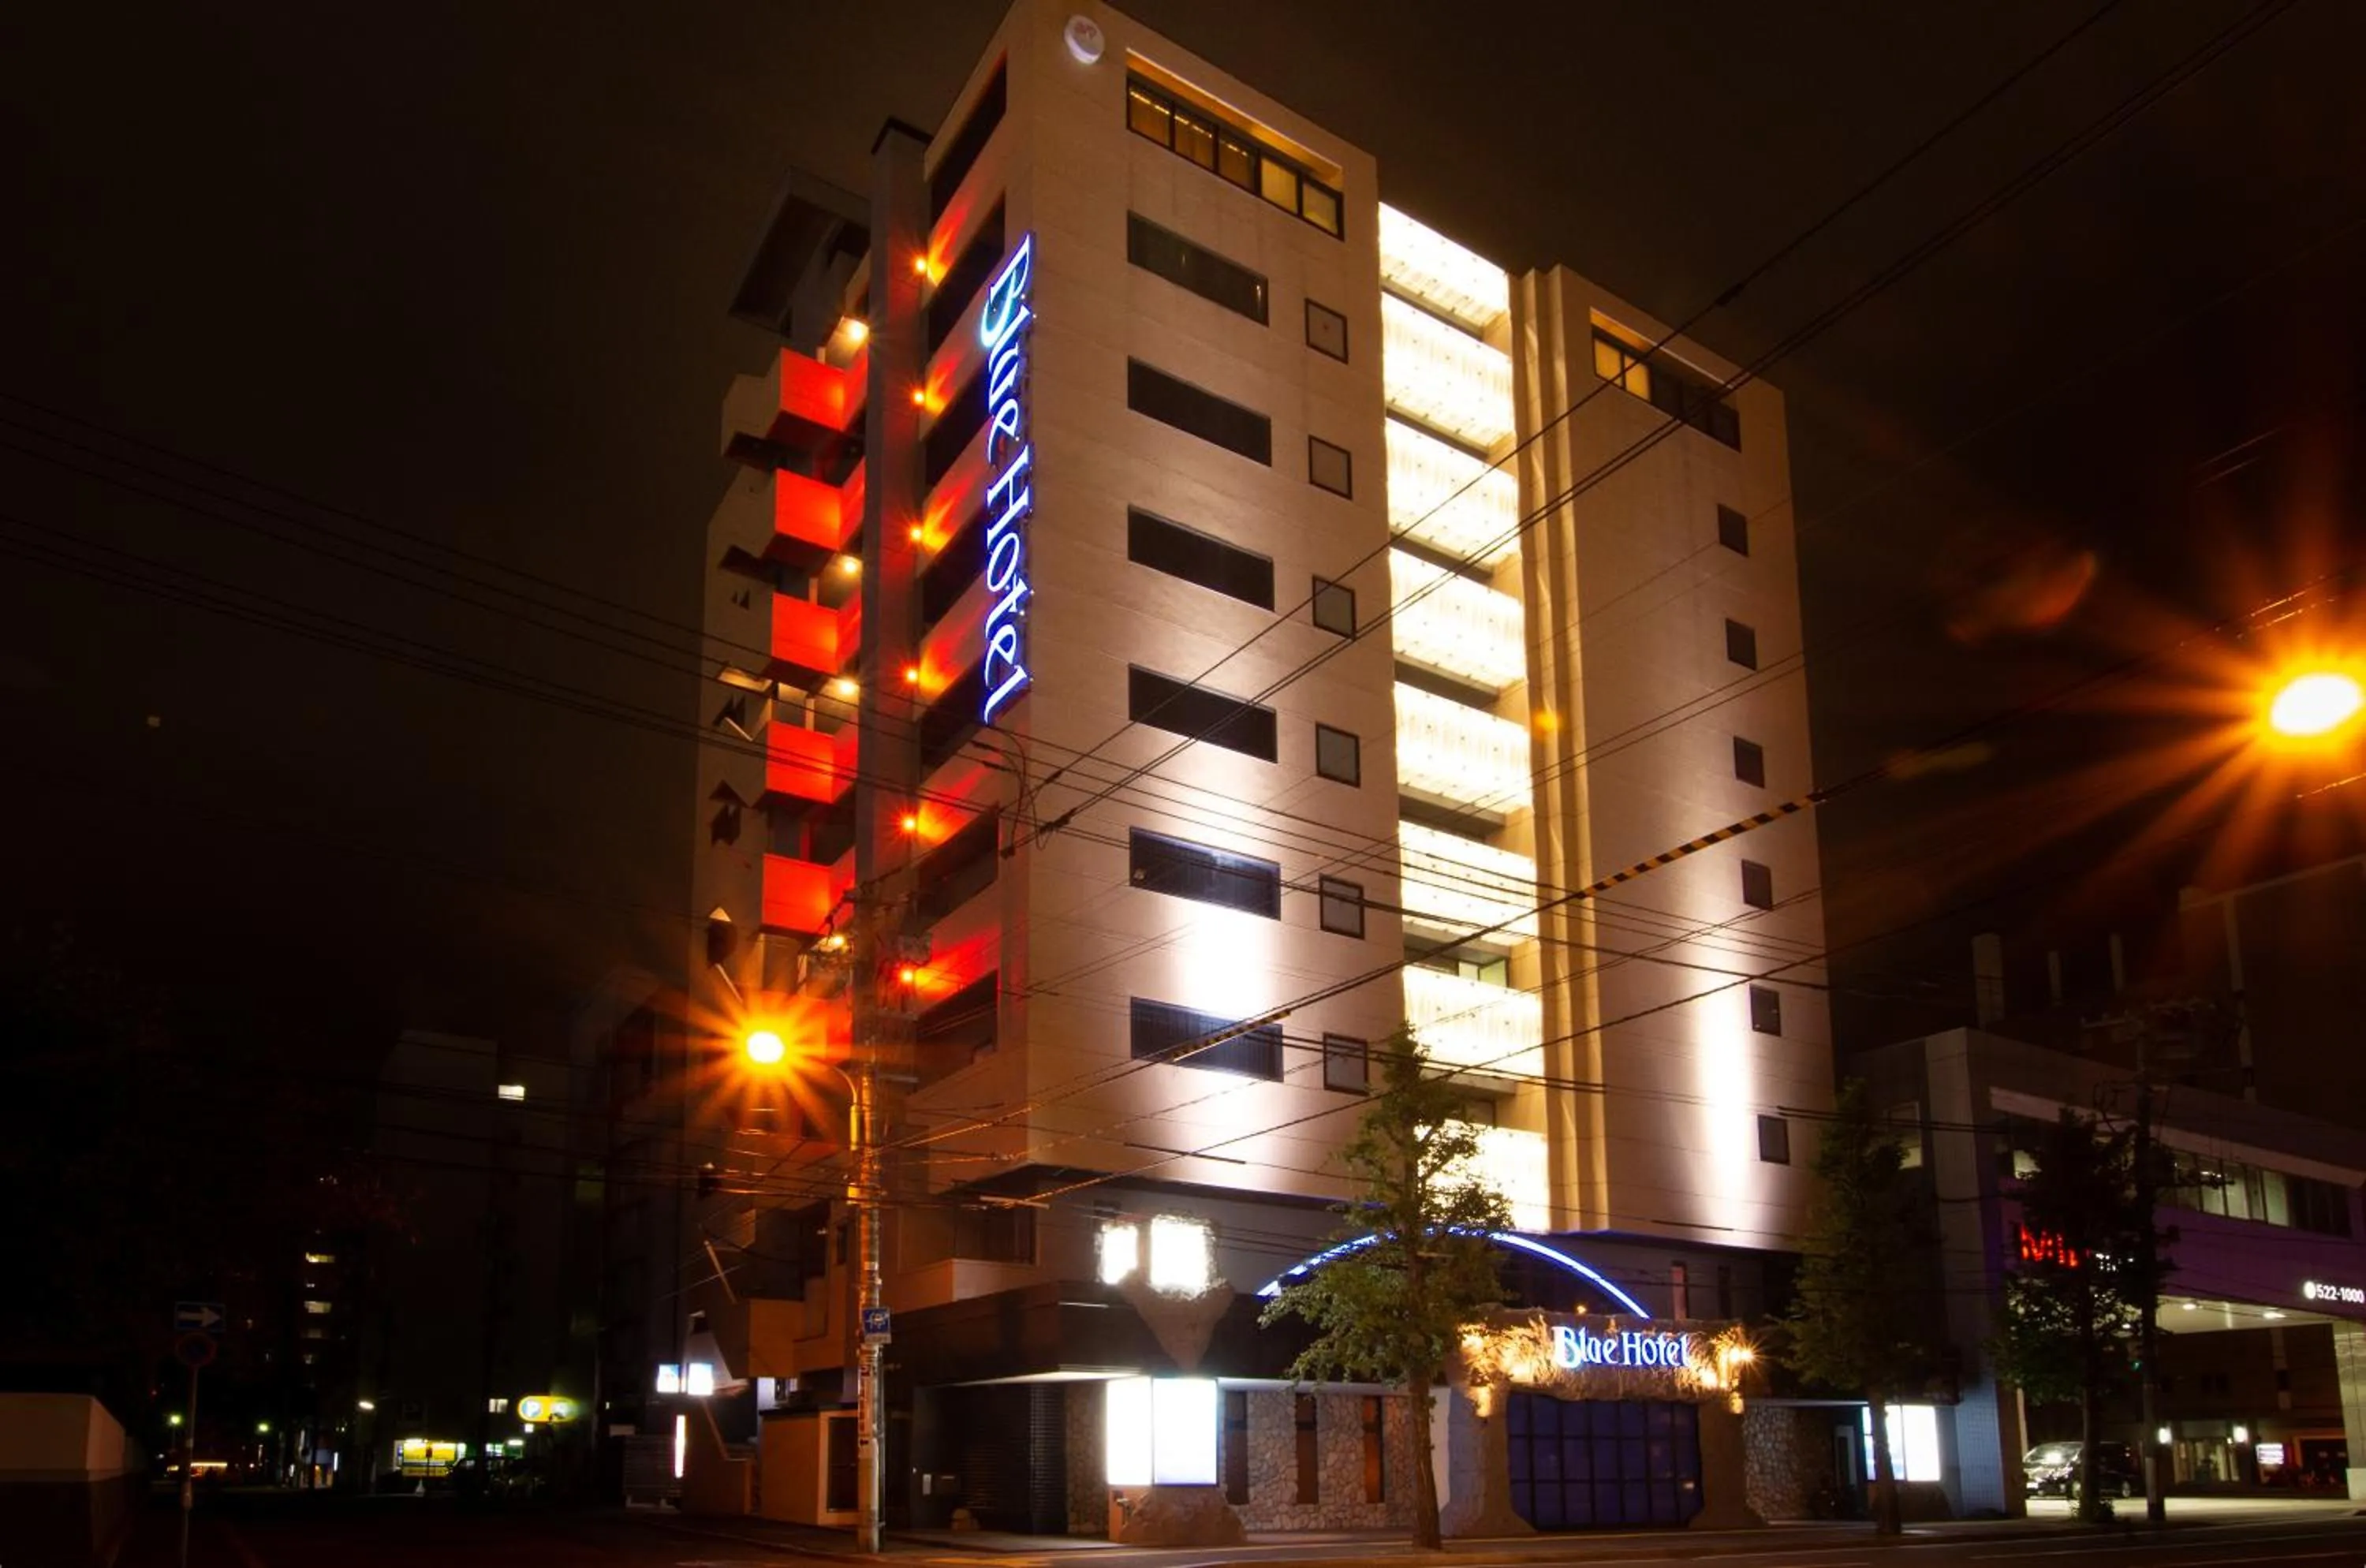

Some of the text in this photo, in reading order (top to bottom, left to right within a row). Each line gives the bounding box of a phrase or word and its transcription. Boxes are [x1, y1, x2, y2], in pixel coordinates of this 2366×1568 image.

[980, 233, 1030, 724] Blue Hotel
[1551, 1326, 1692, 1368] Blue Hotel
